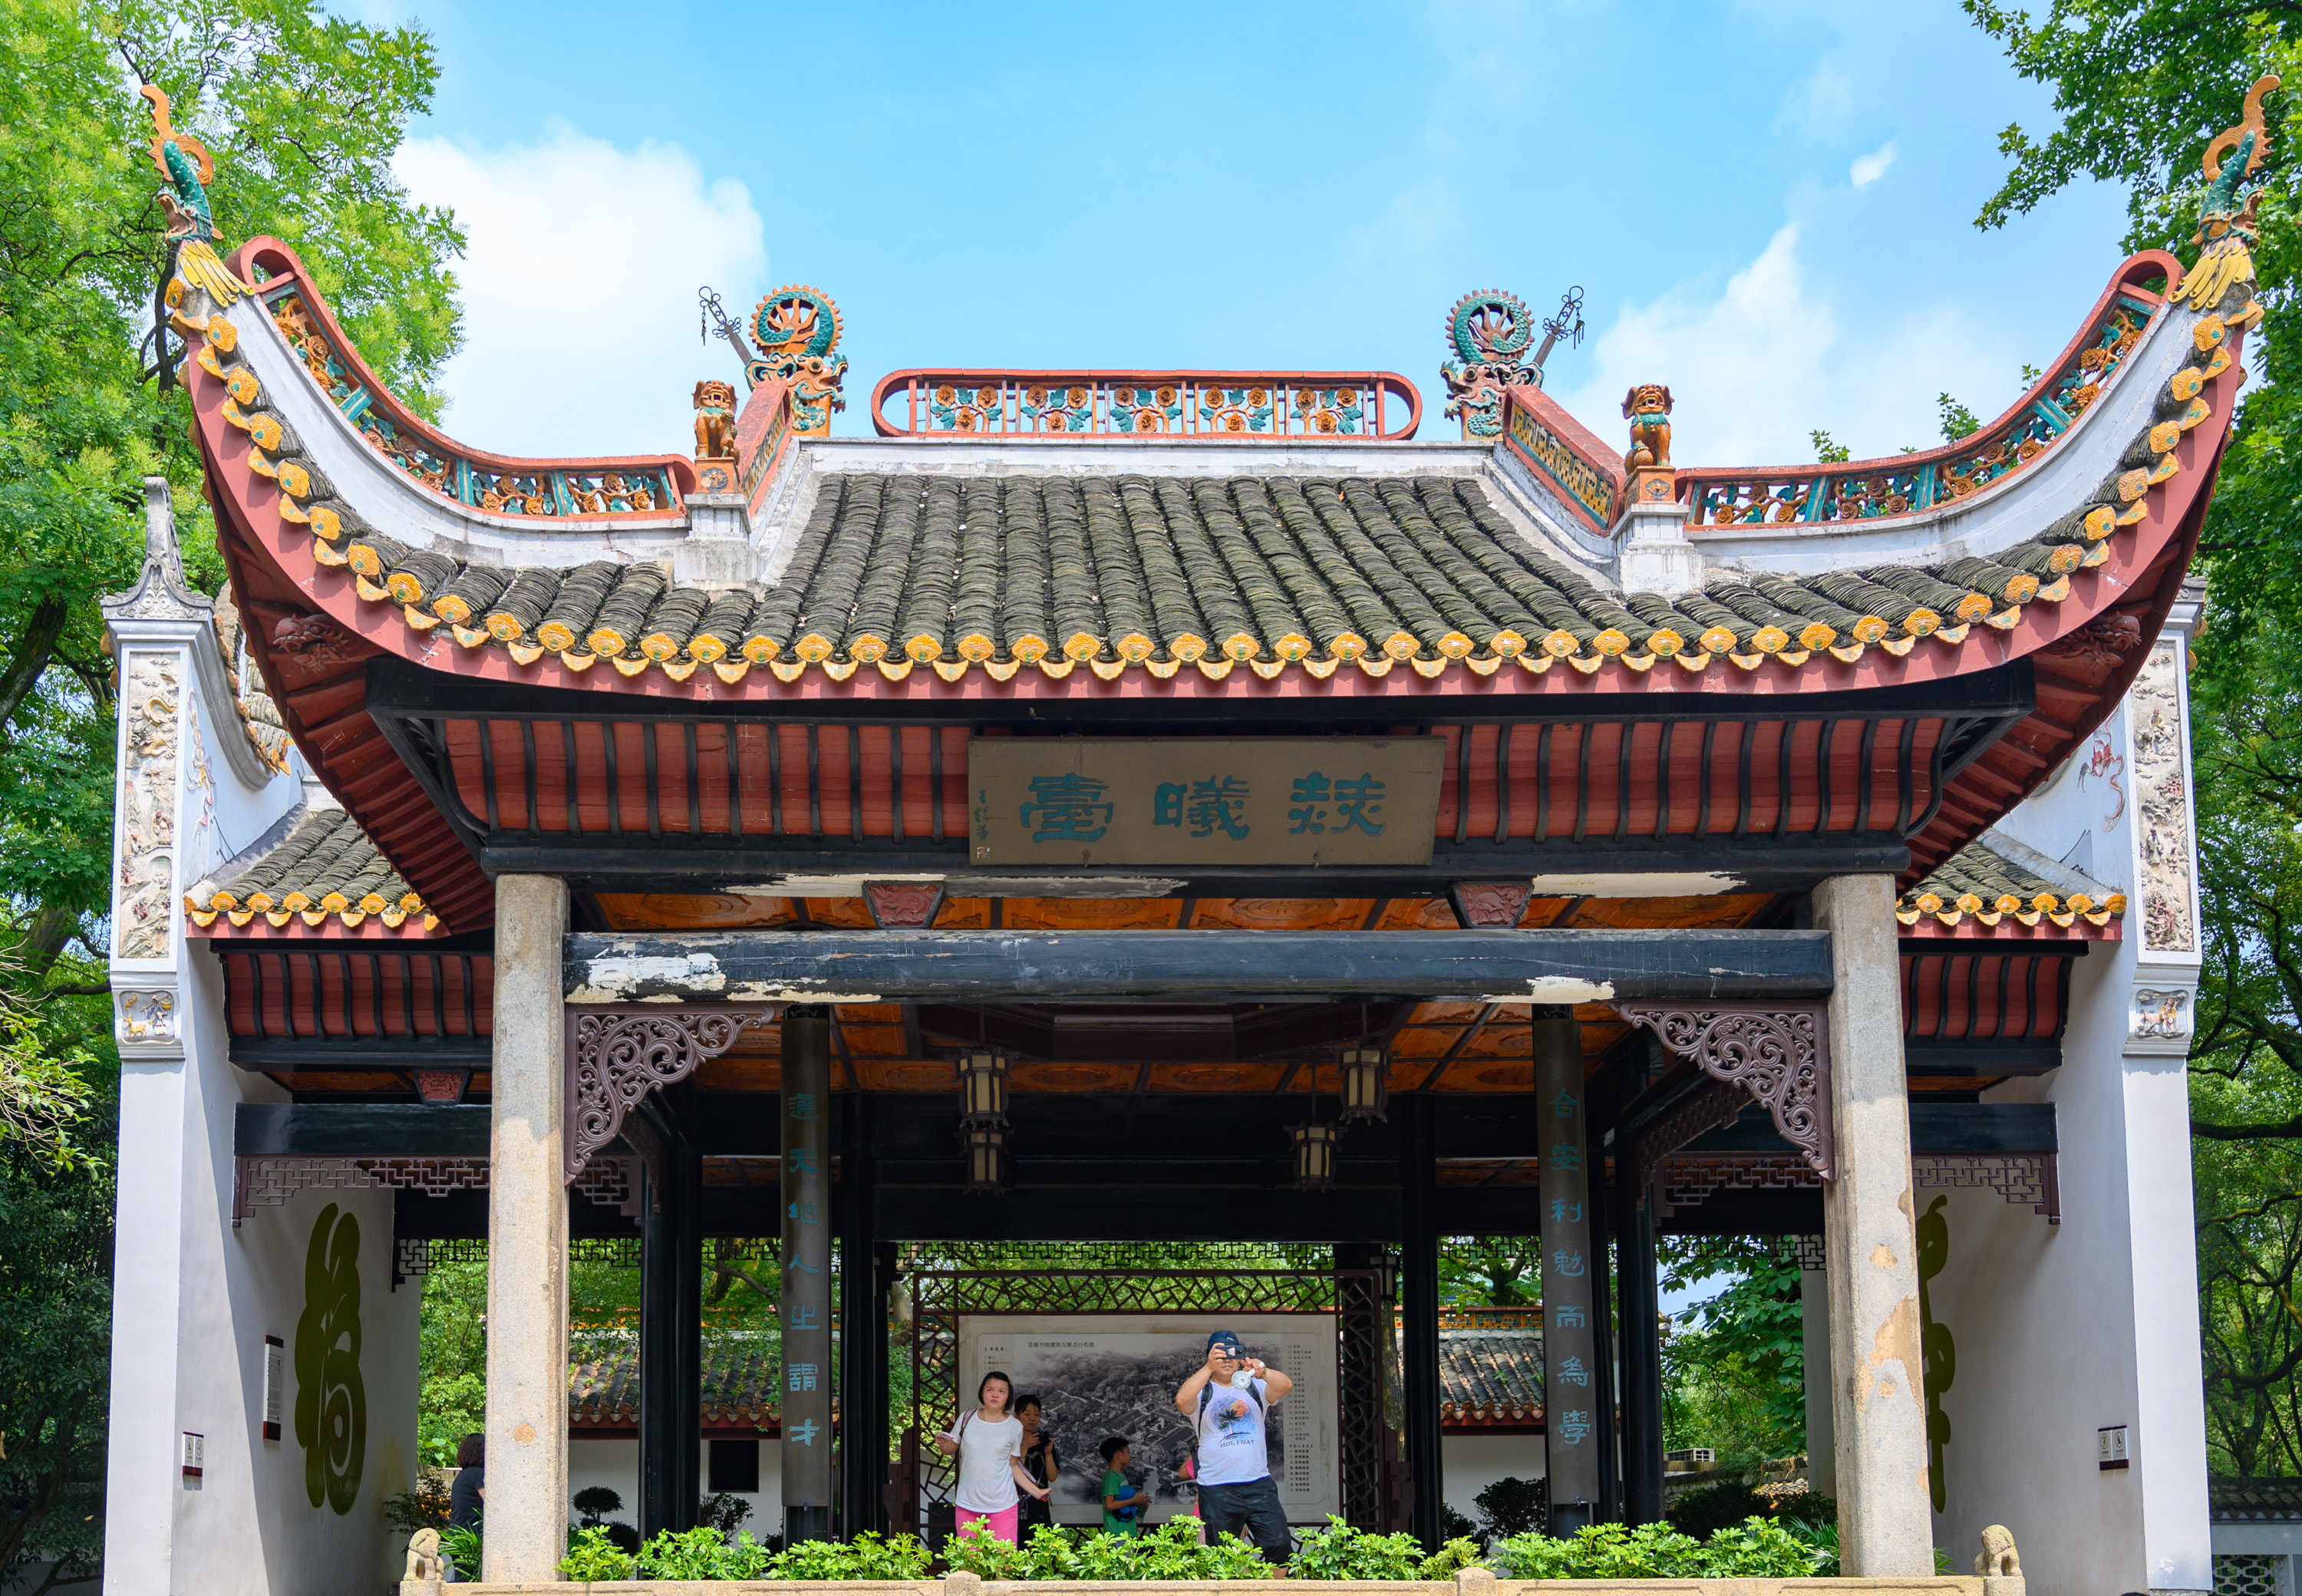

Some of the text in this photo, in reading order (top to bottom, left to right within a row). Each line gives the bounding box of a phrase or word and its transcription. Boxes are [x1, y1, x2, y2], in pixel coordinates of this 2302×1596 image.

[787, 1093, 820, 1446] 通天地人之謂才
[1548, 1088, 1591, 1446] 合安利勉而為學
